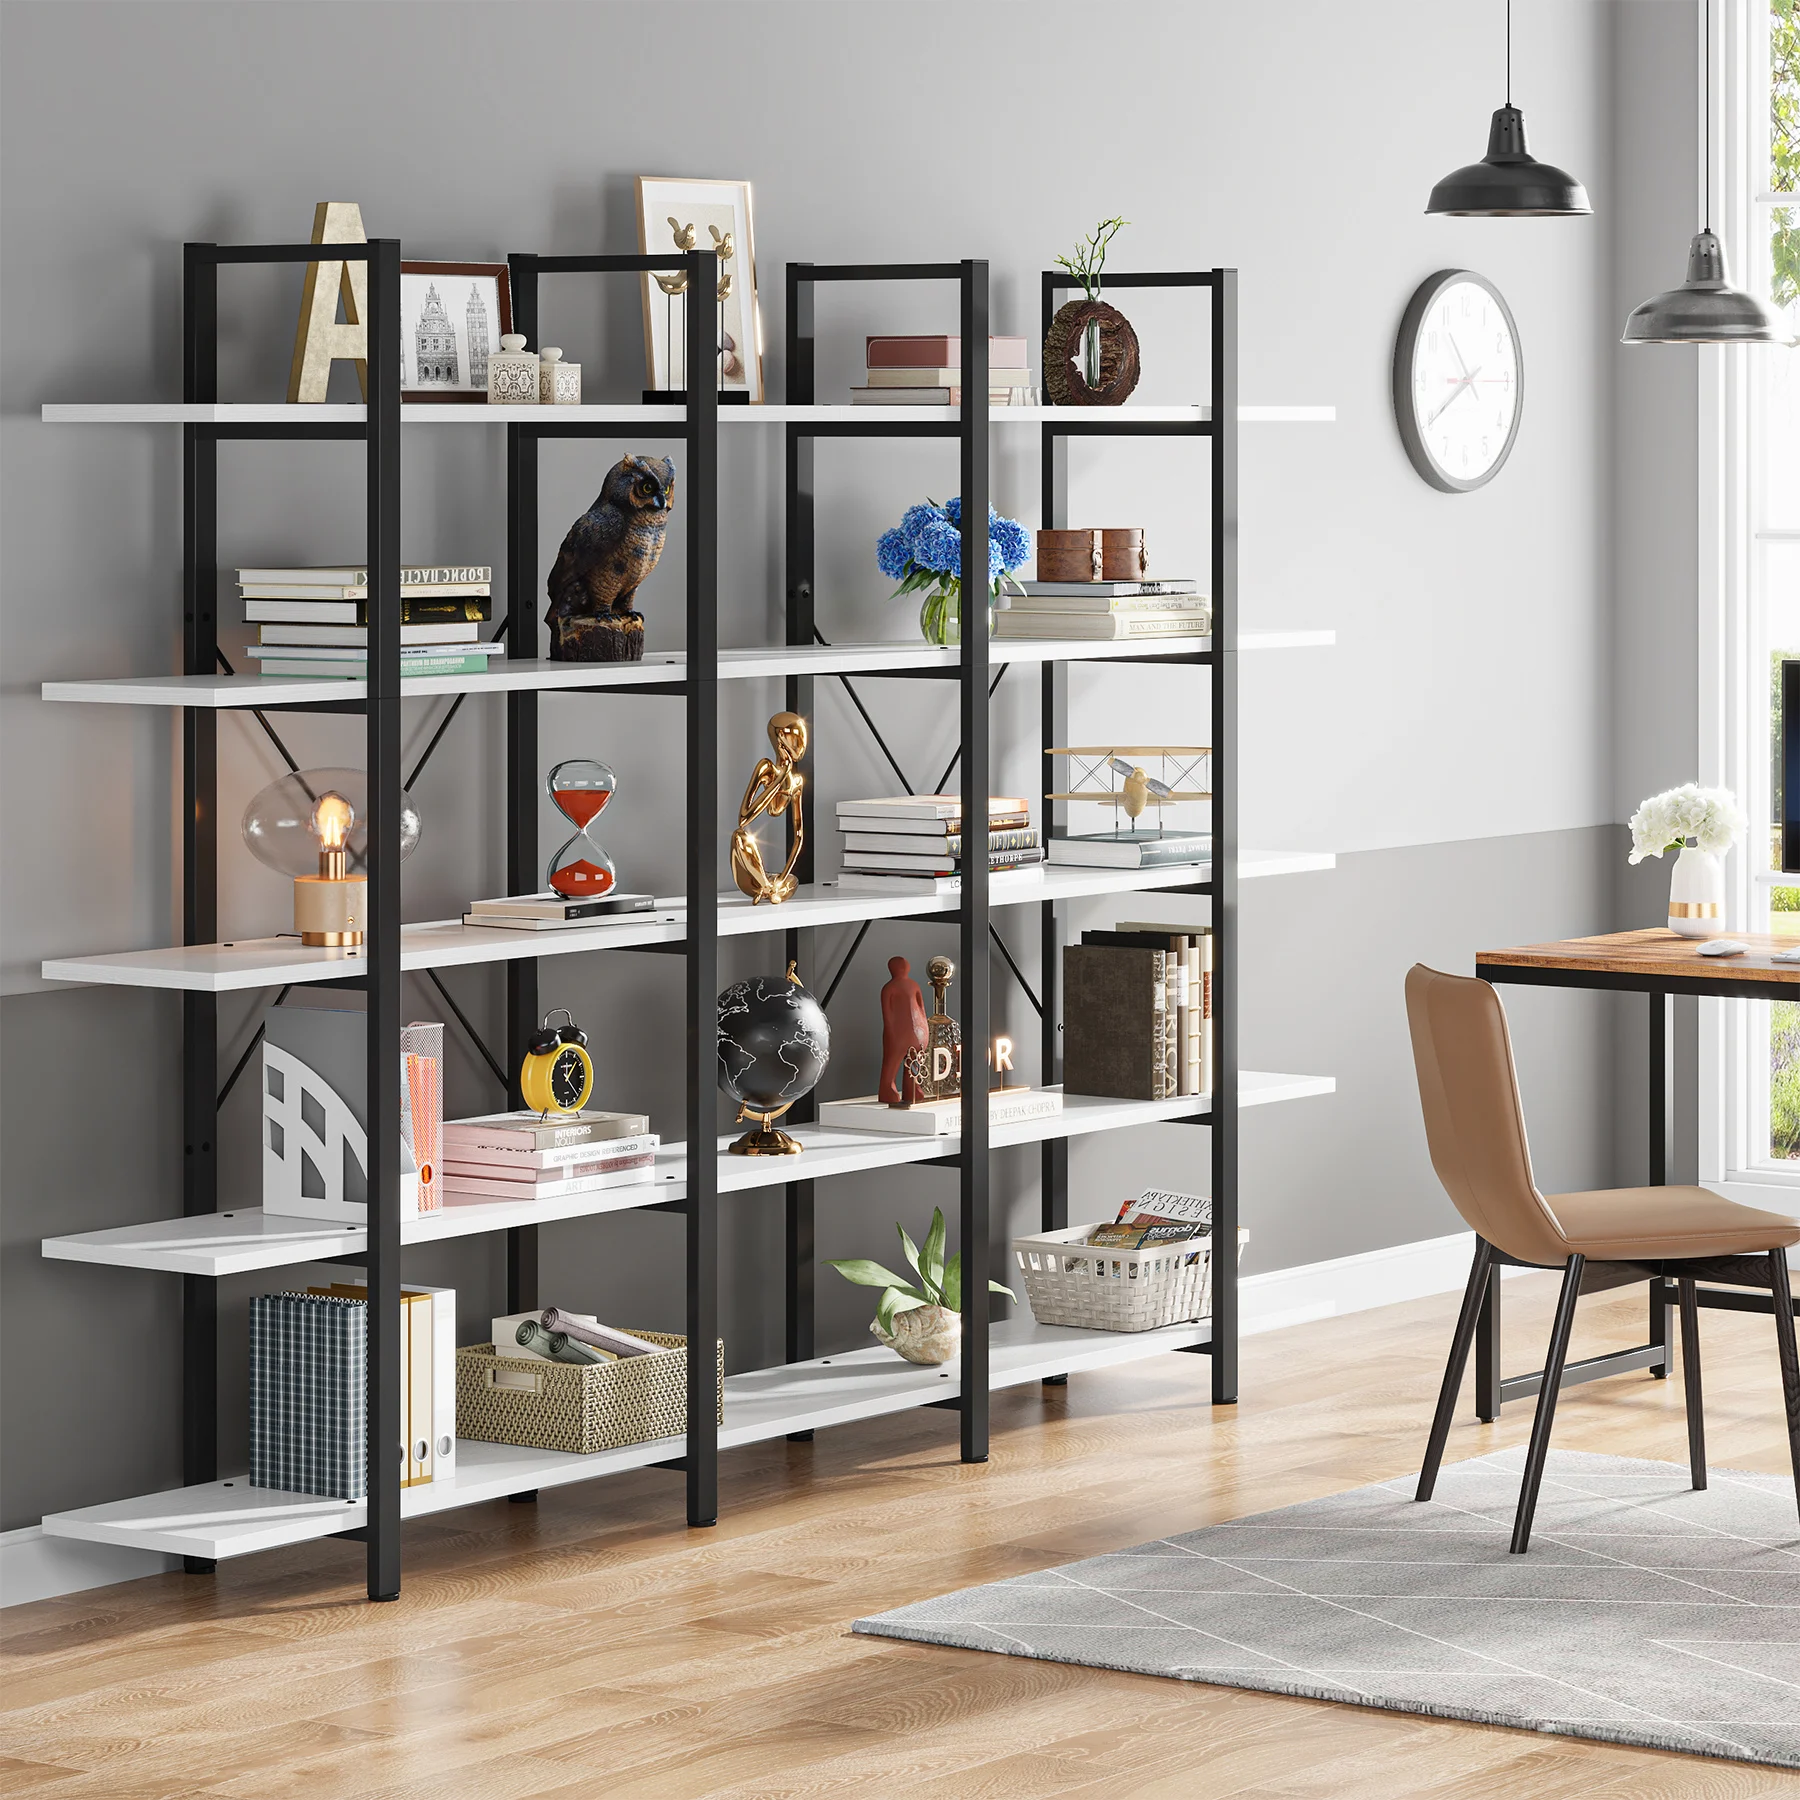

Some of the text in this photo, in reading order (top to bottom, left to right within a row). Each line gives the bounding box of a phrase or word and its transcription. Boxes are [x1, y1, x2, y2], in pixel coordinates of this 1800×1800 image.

[287, 201, 368, 404] A
[1461, 296, 1471, 317] 12
[443, 568, 484, 582] БОРИС
[1147, 622, 1161, 630] AND
[1178, 621, 1205, 629] FUTURE
[989, 853, 1023, 865] ETHORPE
[933, 1038, 1014, 1082] DIR
[989, 1110, 998, 1121] BY
[1000, 1105, 1026, 1120] DEEPAK
[1028, 1100, 1055, 1116] CHOPRA
[555, 1125, 592, 1139] INTERIORS
[553, 1143, 638, 1163] GRAPHIC DESIGN REFERENCED
